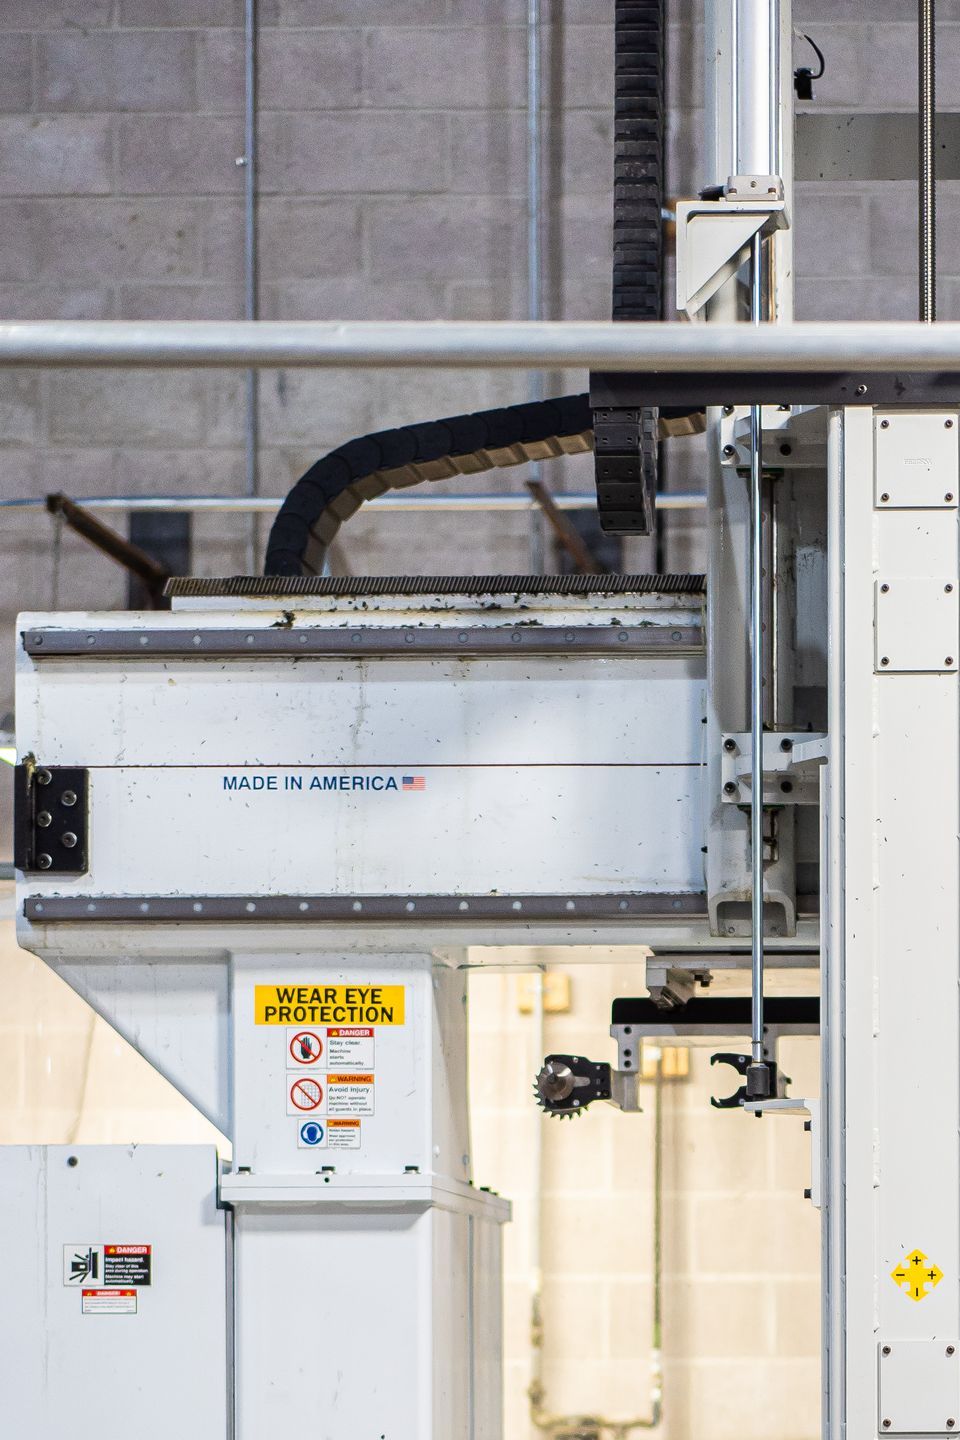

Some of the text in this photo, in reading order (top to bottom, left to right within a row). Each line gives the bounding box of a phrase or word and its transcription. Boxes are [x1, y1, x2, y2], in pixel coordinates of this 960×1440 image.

[223, 776, 398, 790] MADE IN AMERICA
[276, 988, 382, 1004] WEAR EYE
[264, 1006, 394, 1023] PROTECTION
[337, 1075, 371, 1083] WARNING
[116, 1246, 147, 1254] DANGER
